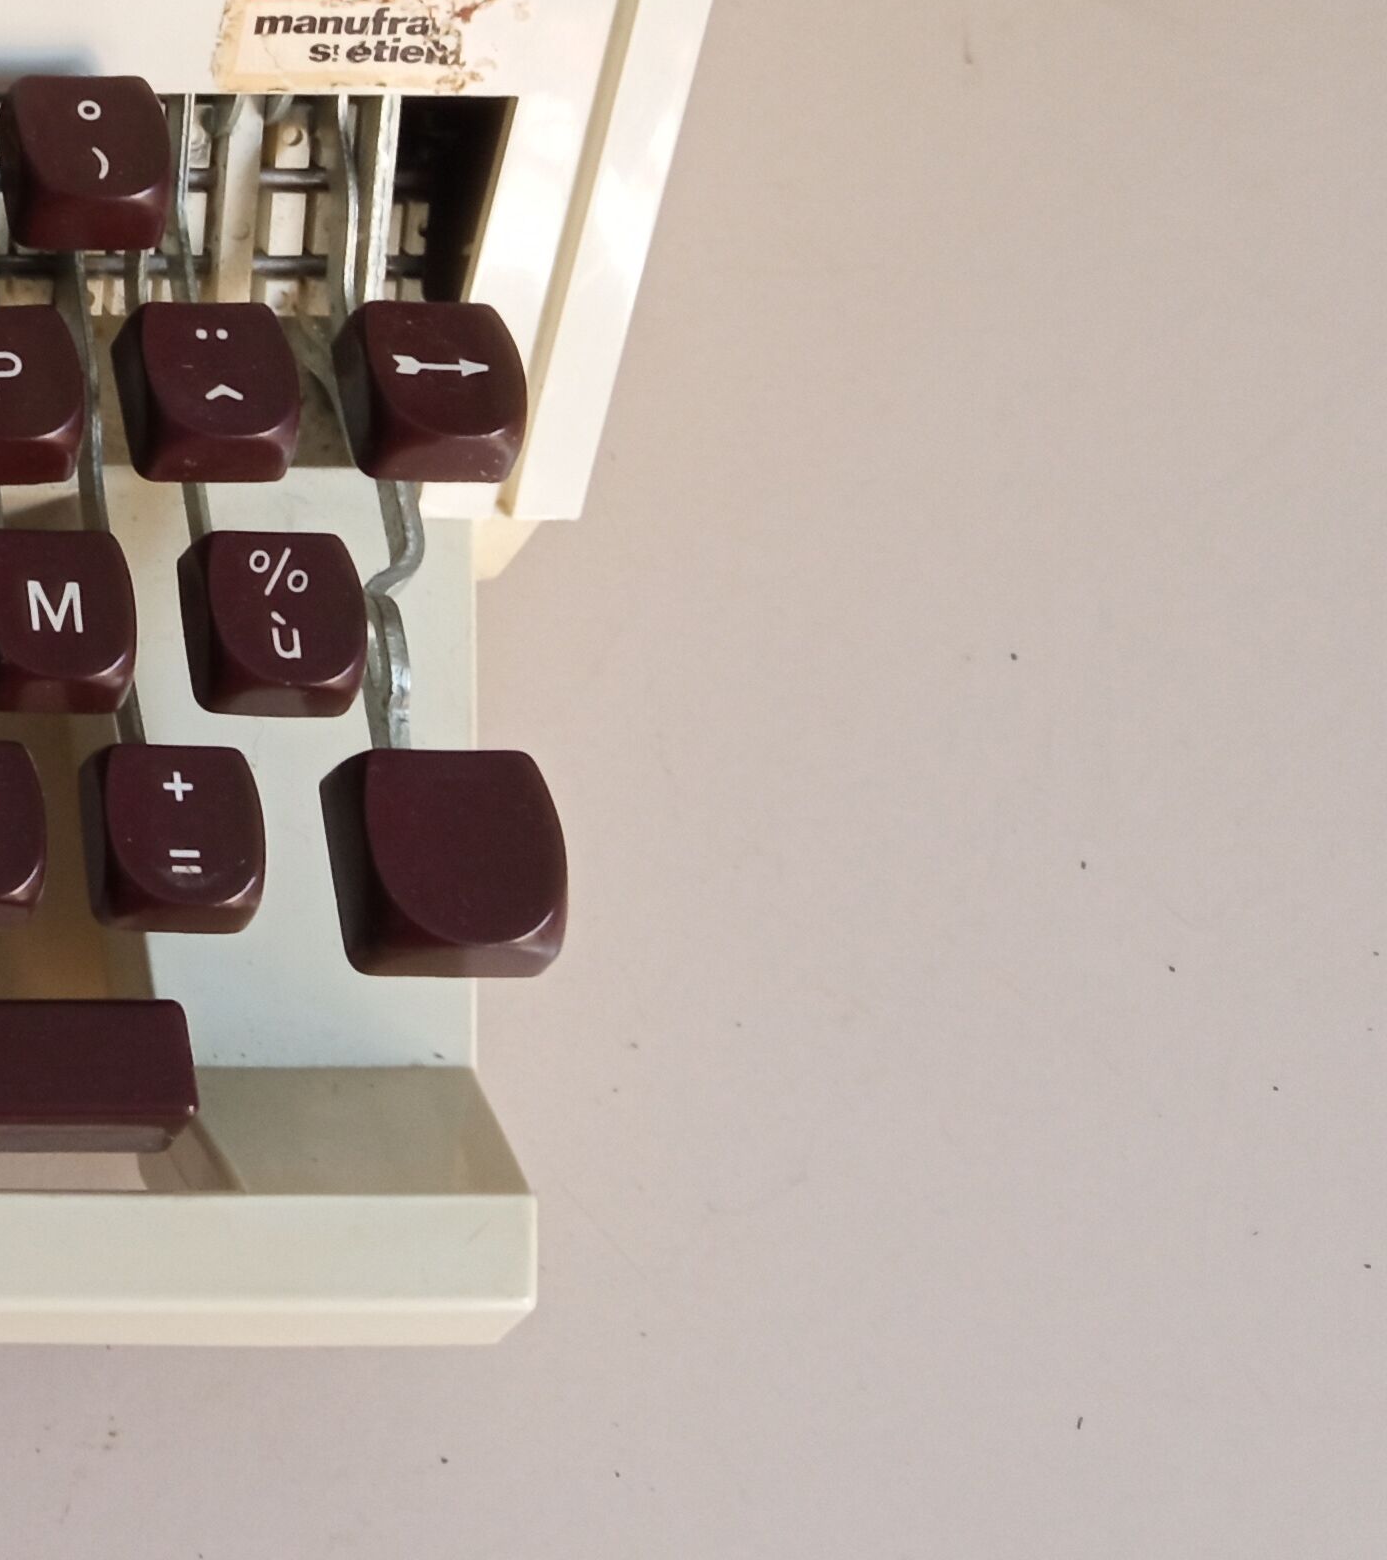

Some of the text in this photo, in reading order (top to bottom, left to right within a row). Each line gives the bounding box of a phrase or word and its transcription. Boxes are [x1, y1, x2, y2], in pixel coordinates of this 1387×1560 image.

[248, 547, 309, 596] %
[26, 579, 84, 634] M
[270, 611, 302, 659] ù
[162, 771, 194, 802] +
[169, 849, 202, 874] =
